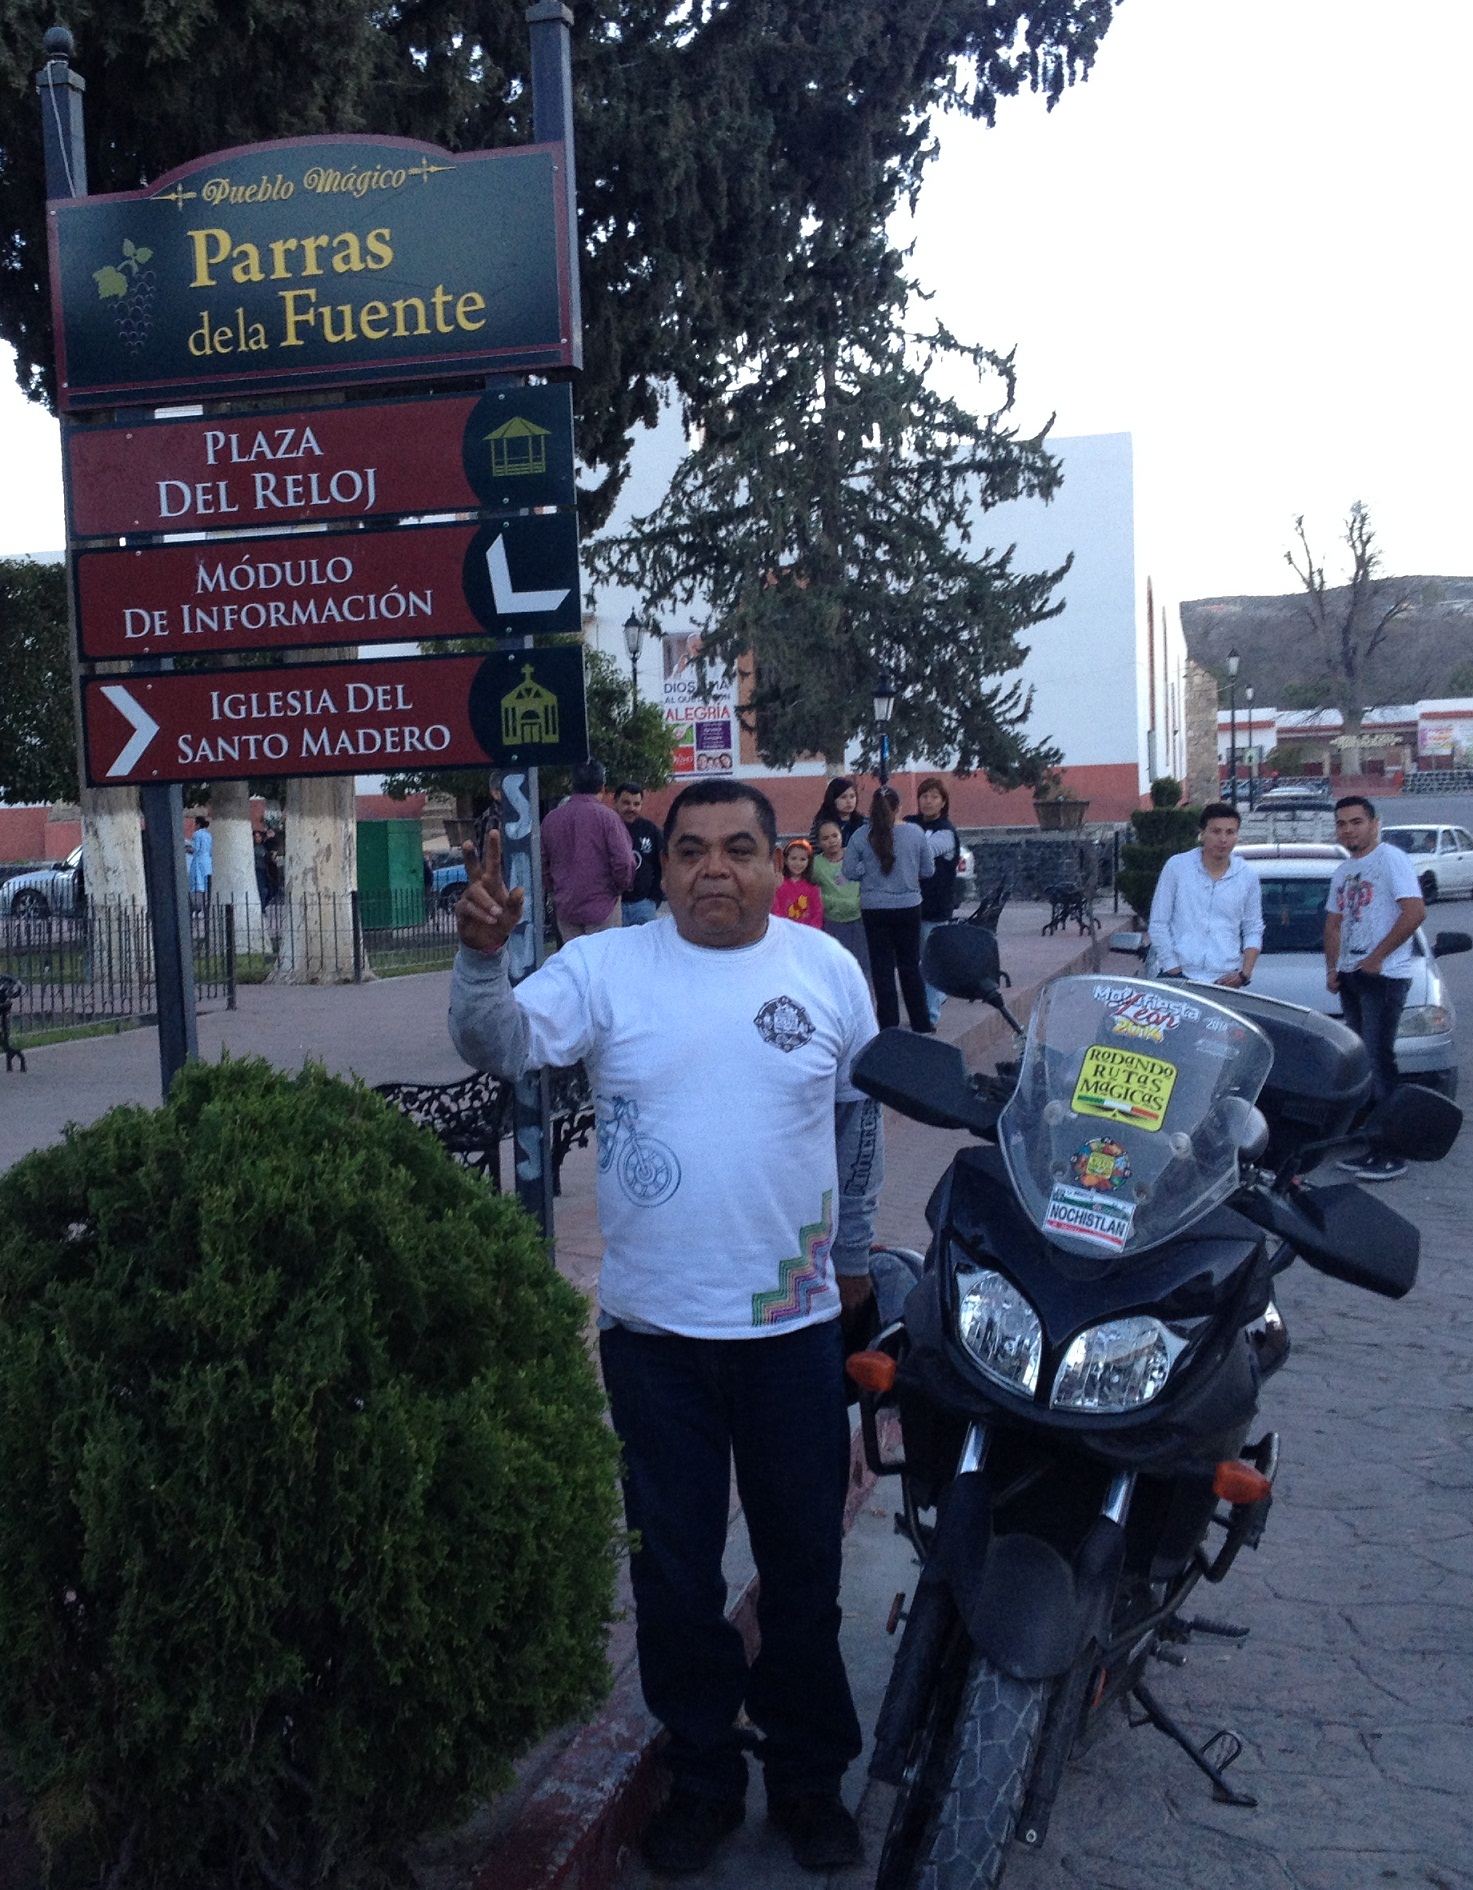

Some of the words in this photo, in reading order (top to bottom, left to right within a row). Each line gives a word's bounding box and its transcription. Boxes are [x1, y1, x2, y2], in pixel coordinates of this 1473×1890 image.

[202, 173, 295, 206] Pueblo
[303, 164, 407, 198] Mágico
[187, 227, 394, 289] Parras
[278, 284, 487, 348] Fuente
[203, 426, 325, 466] PLAZA
[156, 480, 240, 518] DEL
[251, 467, 378, 511] RELOJ
[196, 554, 354, 594] MÓDULO
[123, 608, 169, 639] DE
[180, 585, 434, 635] INFORMACIÓN
[209, 687, 337, 721] IGLESIA
[345, 682, 414, 714] DEL
[664, 681, 696, 694] DIOS
[665, 703, 730, 721] ALEGRÍA
[176, 733, 290, 766] SANTO
[300, 723, 452, 758] MADERO
[1112, 1018, 1165, 1044] 2014
[1113, 993, 1179, 1030] León
[1050, 1202, 1128, 1239] NOCHISTLAN
